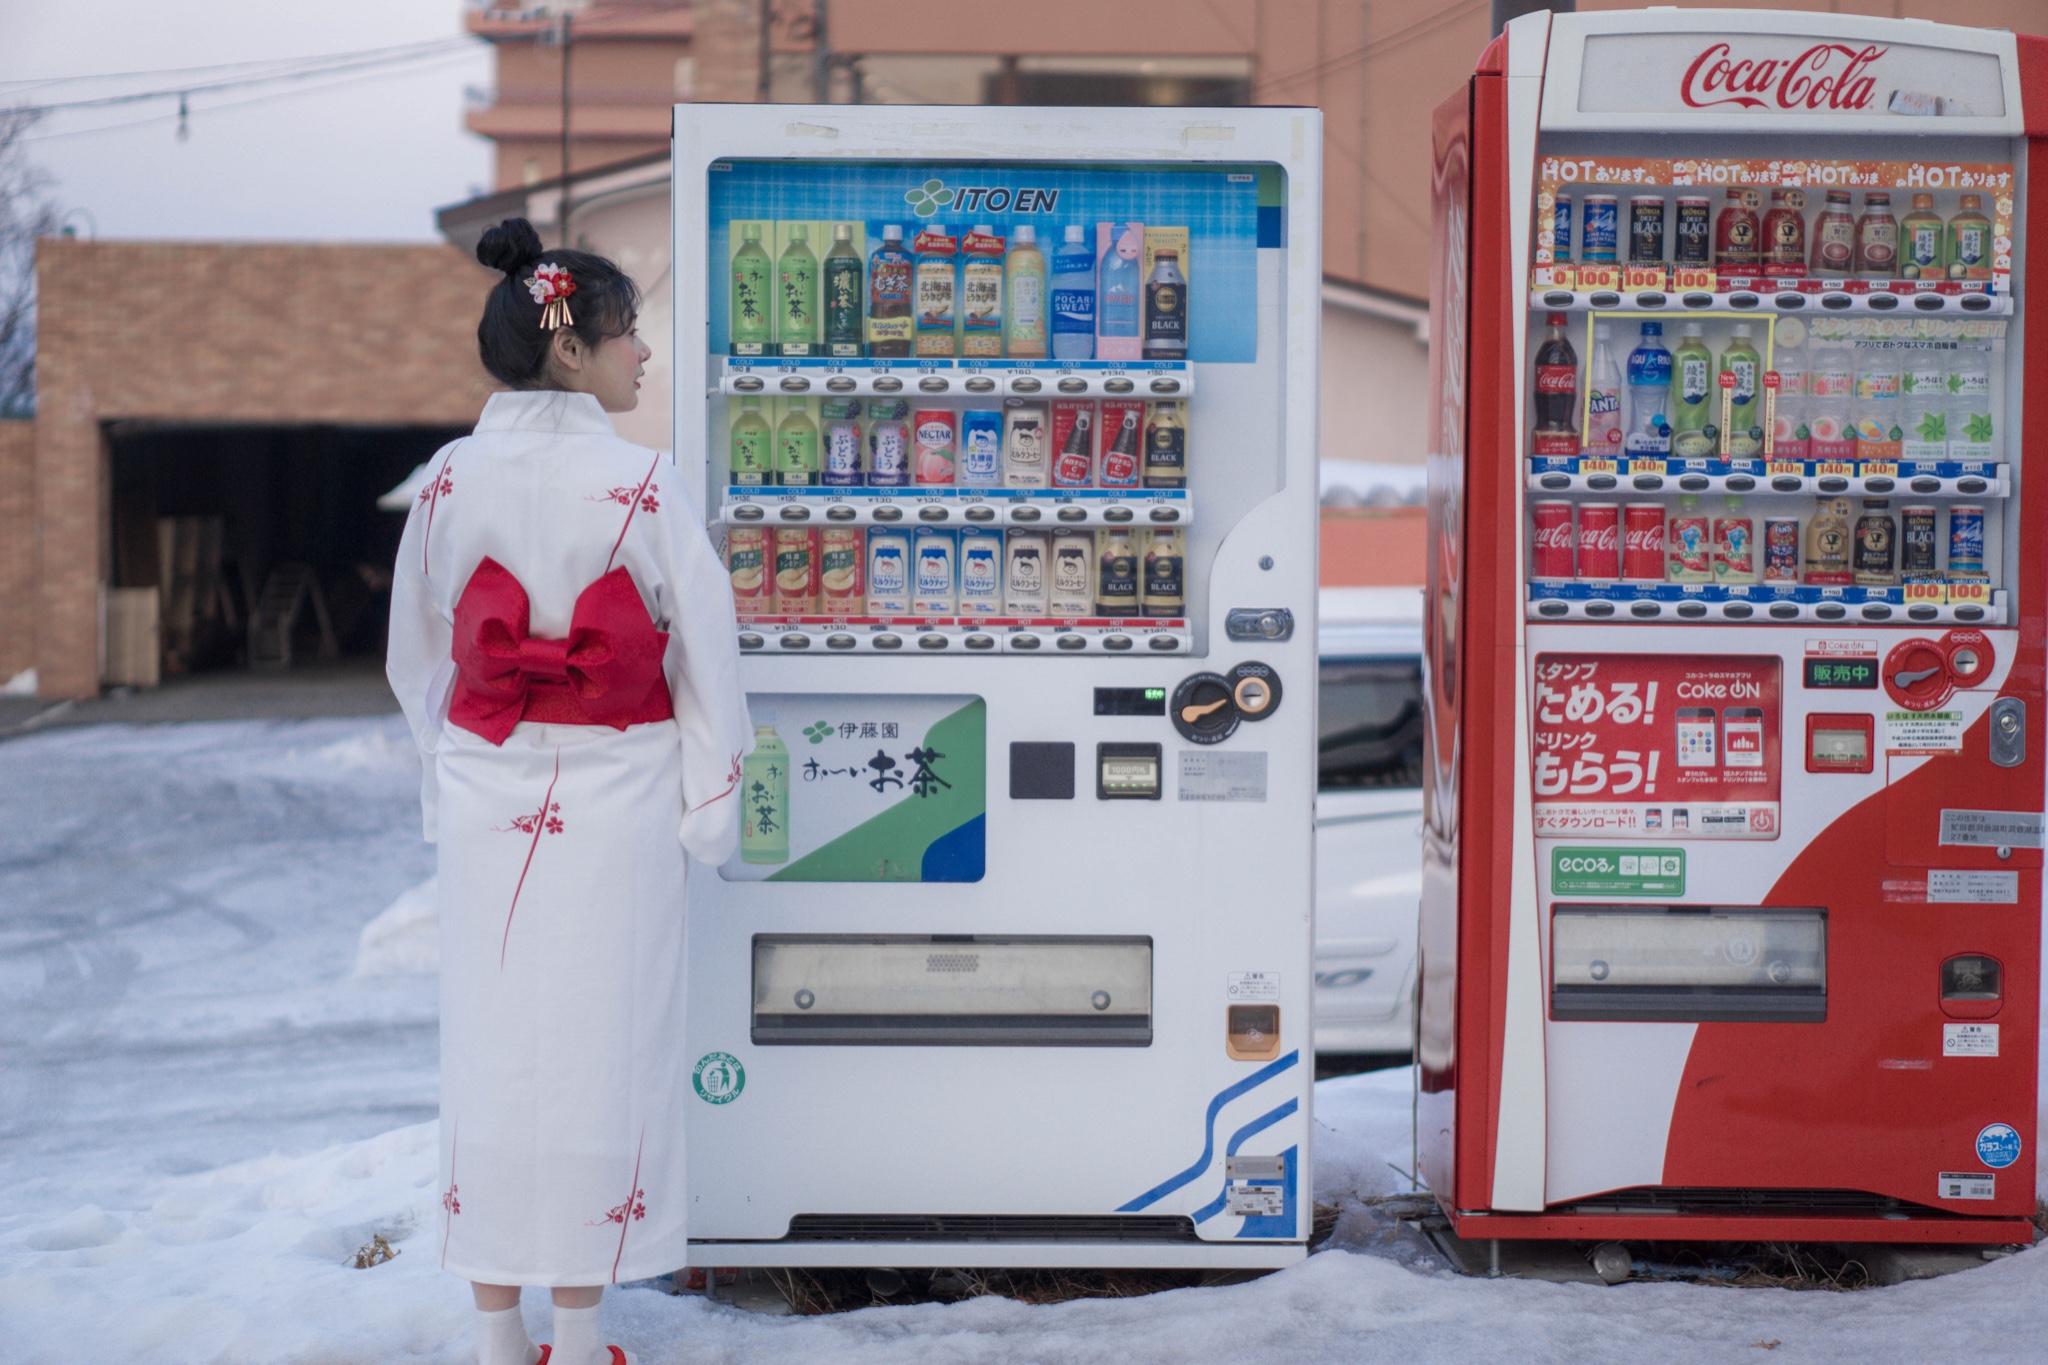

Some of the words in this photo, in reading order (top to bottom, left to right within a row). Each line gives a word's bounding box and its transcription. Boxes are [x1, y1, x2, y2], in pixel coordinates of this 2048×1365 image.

[1680, 43, 1890, 110] Coca-Cola
[1541, 158, 1646, 182] HOTあります
[1907, 163, 2011, 188] HOTあります
[952, 188, 1012, 213] ITO
[1012, 189, 1060, 213] EN
[1635, 208, 1661, 216] GEORGIA
[1681, 208, 1707, 216] GEORGIA
[1632, 222, 1663, 234] BLACK
[1678, 223, 1708, 235] BLACK
[874, 275, 908, 292] むぎ茶
[1576, 271, 1617, 286] 100円
[1624, 272, 1664, 286] 100円
[1675, 272, 1715, 288] 100円
[920, 281, 952, 292] 北海道
[966, 281, 997, 293] 北海道
[738, 281, 761, 319] お茶
[785, 281, 807, 319] お茶
[920, 292, 952, 302] とうきび茶
[966, 293, 997, 302] とうきび茶
[1104, 292, 1136, 305] evian
[1055, 303, 1090, 312] SWEAT
[1151, 320, 1180, 330] BLACK
[1539, 373, 1576, 388] Coca-Cola
[1686, 365, 1698, 390] 綾鷹
[1589, 396, 1619, 414] ANTA
[918, 429, 952, 440] NECTAR
[836, 434, 849, 470] ぶどう
[882, 434, 895, 470] ぶどう
[970, 453, 993, 463] 乳酸菌
[1011, 451, 1040, 459] ミルクコーヒー
[1150, 453, 1177, 462] BLACK
[970, 462, 993, 470] ソーダ
[1582, 460, 1614, 470] 140円
[1631, 460, 1664, 470] 140円
[1769, 464, 1802, 474] 140円
[1818, 464, 1851, 474] 140円
[1863, 464, 1895, 474] 140円
[1906, 531, 1934, 544] BLACK
[1680, 550, 1702, 560] Qoo
[1726, 551, 1747, 560] Qoo
[873, 577, 903, 586] ミルクティー
[919, 577, 948, 586] ミルクティー
[966, 578, 994, 586] ミルクティー
[1012, 579, 1041, 588] ミルクコーヒー
[1056, 579, 1084, 588] ミルクコーヒー
[1108, 582, 1133, 591] BLACK
[1150, 582, 1177, 591] BLACK
[1906, 584, 1946, 598] 100円
[1949, 584, 1989, 598] 100円
[1828, 642, 1850, 650] Coke
[1850, 642, 1865, 650] ON
[1813, 664, 1870, 682] 販売中
[1676, 682, 1727, 699] Coke
[1729, 678, 1760, 699] ON
[1536, 682, 1659, 725] ためる!
[838, 721, 899, 740] 伊藤園
[802, 746, 953, 798] お〜いお茶
[1536, 750, 1660, 796] もらう!
[750, 779, 780, 835] お茶
[1944, 814, 1986, 822] ここの住所は
[1950, 834, 1978, 842] 27番地
[695, 1053, 741, 1075] のんだあとは
[699, 1088, 740, 1104] リサイクル
